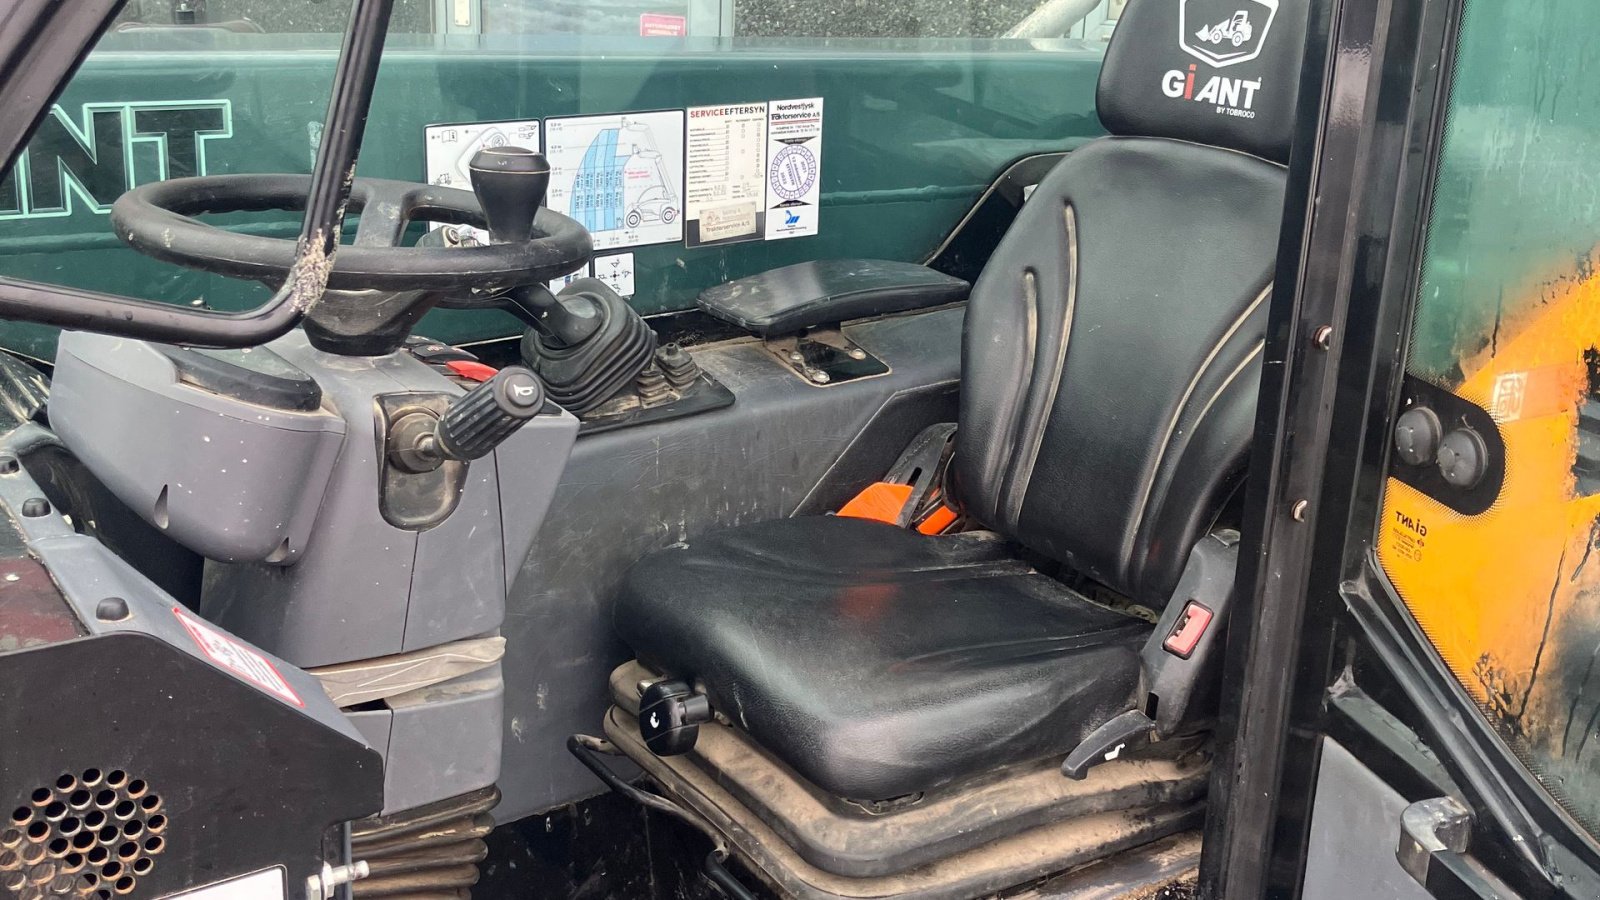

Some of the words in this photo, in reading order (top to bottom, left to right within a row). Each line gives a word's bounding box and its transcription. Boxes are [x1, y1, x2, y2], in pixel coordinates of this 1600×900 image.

[690, 106, 765, 118] SERVICEEFTERSYN
[1216, 106, 1225, 115] BY
[1226, 108, 1256, 119] TOBROCO
